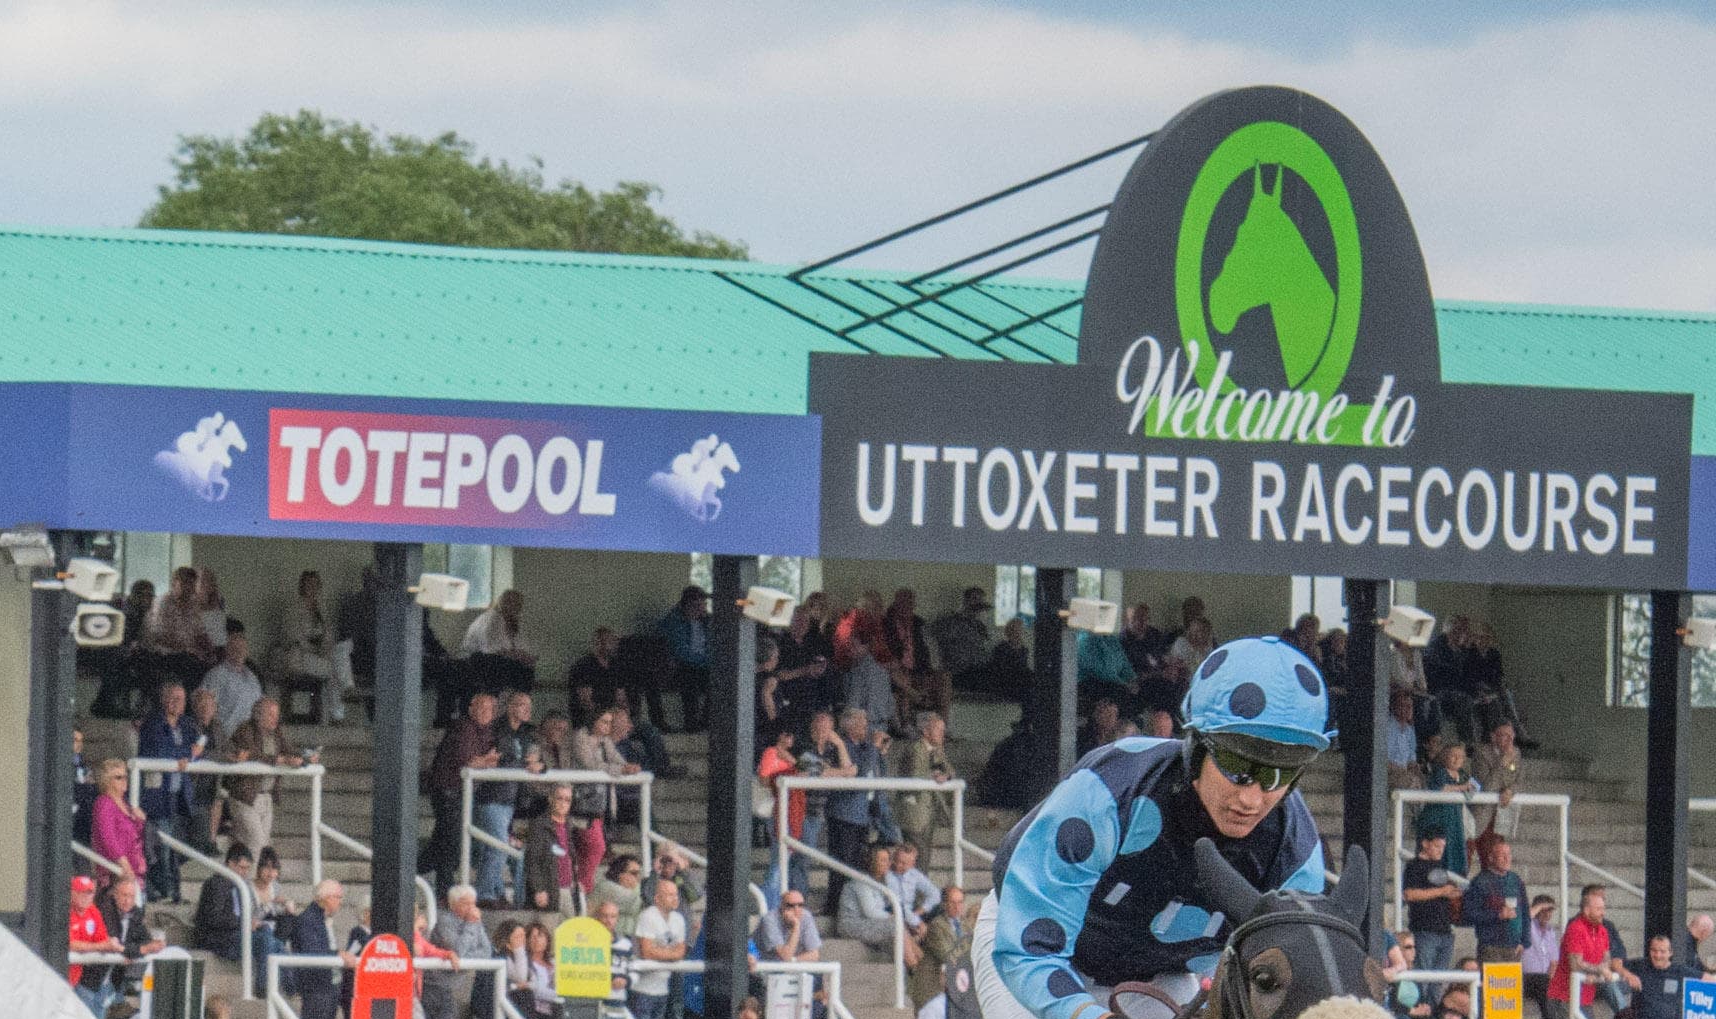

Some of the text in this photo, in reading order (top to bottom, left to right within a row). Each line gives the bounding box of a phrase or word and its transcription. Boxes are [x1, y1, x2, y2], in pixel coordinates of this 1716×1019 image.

[1116, 335, 1417, 447] Welcome to
[279, 426, 617, 516] TOTEPOOL
[855, 442, 1658, 555] UTTOXETER RACECOURSE
[561, 946, 605, 965] DELTA
[1488, 975, 1517, 989] Hunter
